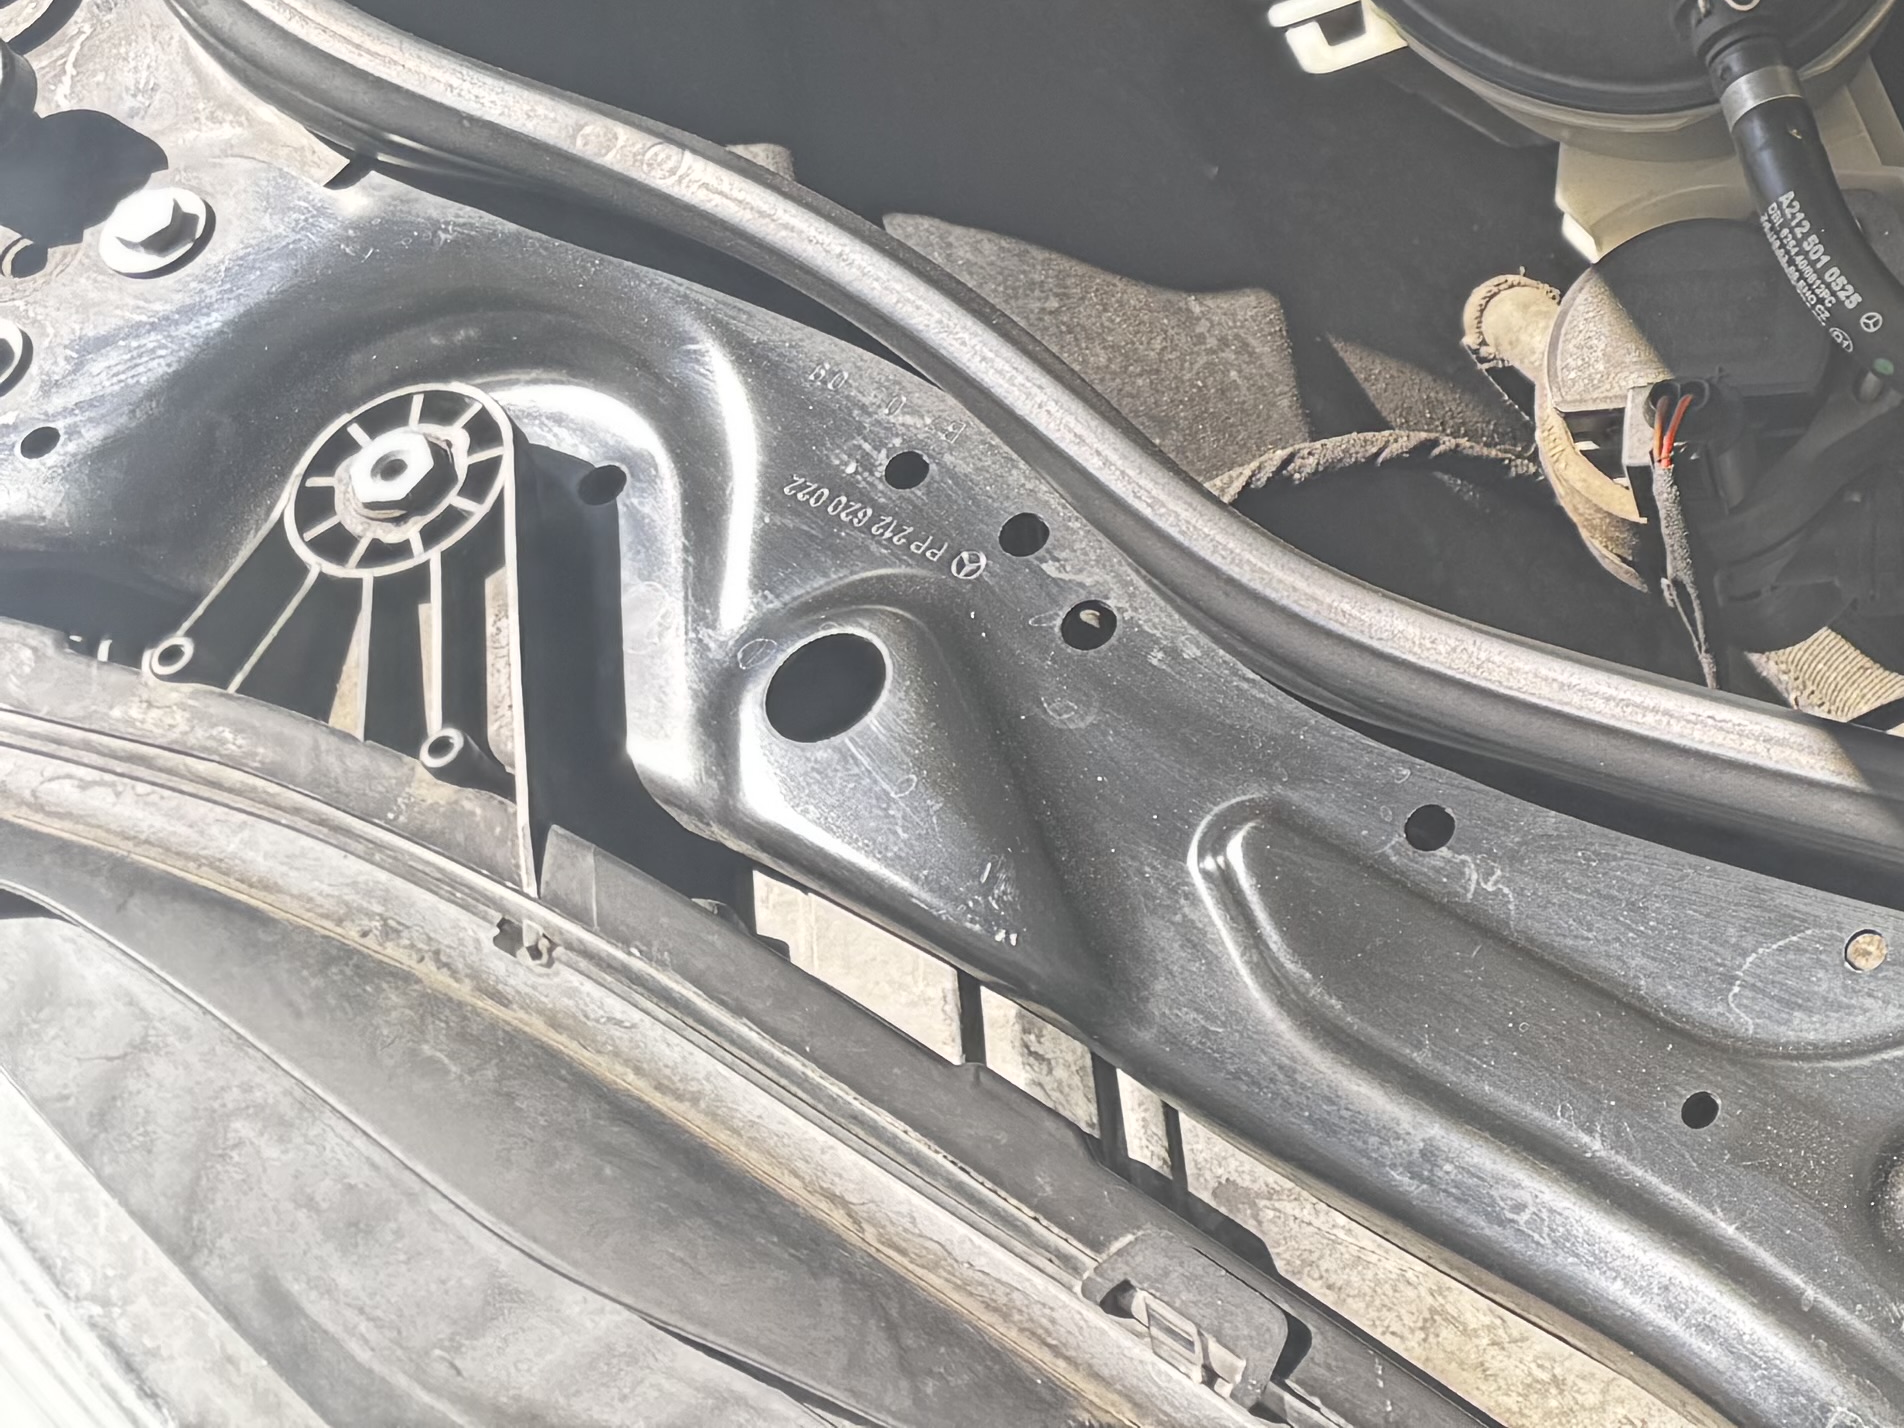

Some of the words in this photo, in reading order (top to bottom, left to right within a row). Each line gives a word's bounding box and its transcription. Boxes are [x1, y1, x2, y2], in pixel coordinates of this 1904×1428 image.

[1778, 190, 1811, 238] A212
[1802, 234, 1831, 269] 501
[1824, 266, 1863, 310] 0525
[783, 473, 830, 508] 022
[827, 495, 873, 528] 620
[871, 515, 915, 545] 212
[909, 535, 949, 563] PP
